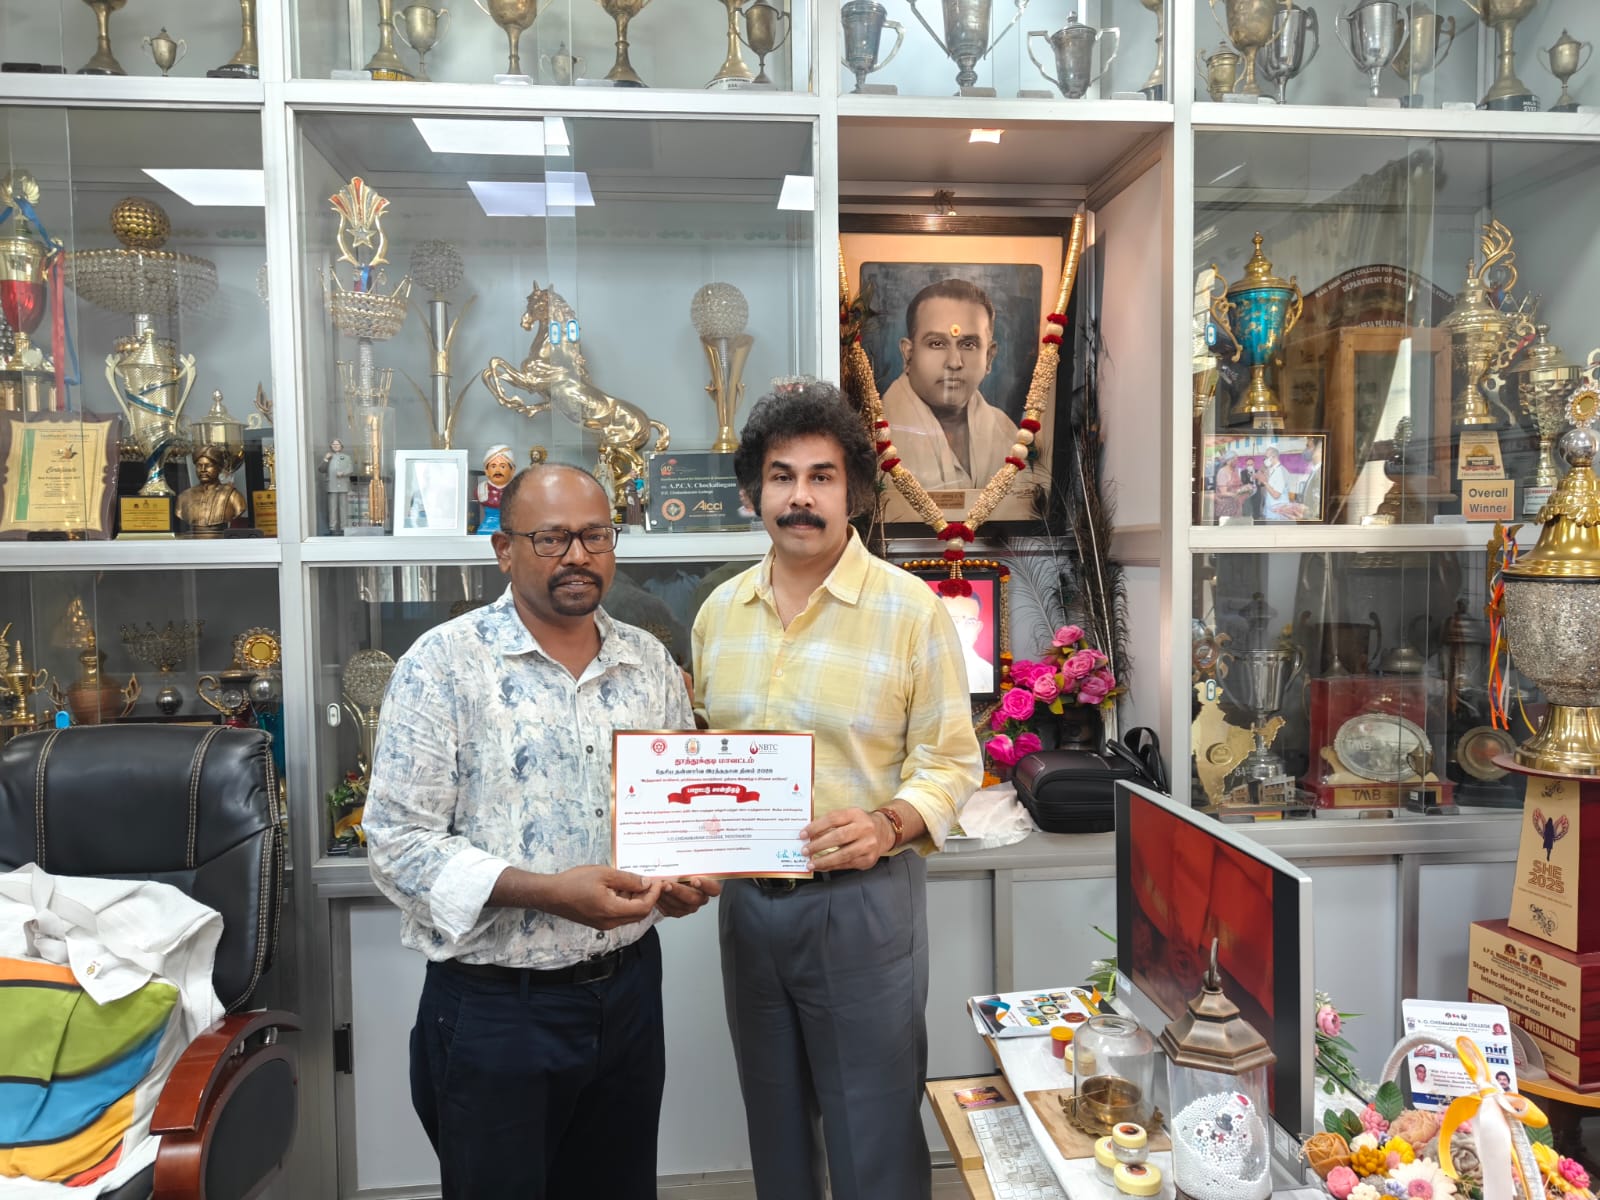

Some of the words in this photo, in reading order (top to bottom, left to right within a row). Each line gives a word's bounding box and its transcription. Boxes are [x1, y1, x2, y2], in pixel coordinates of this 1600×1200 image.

[1356, 267, 1381, 276] COLLEGE
[1342, 276, 1383, 292] DEPARTMENT
[1384, 276, 1393, 284] OF
[1469, 488, 1508, 498] Overall
[1470, 504, 1507, 513] Winner
[758, 743, 778, 751] NBTC
[719, 756, 755, 764] மாவட்டம்
[1352, 789, 1381, 800] TMB
[1533, 860, 1562, 880] SHE
[1528, 871, 1565, 893] 2025
[1472, 961, 1489, 974] Stage
[1490, 967, 1499, 977] for
[1500, 971, 1526, 990] Heritage
[1527, 982, 1539, 995] and
[1540, 990, 1576, 1013] Excellence
[1480, 974, 1524, 999] Intercollegiate
[1525, 994, 1551, 1011] Cultural
[1552, 1006, 1566, 1019] Fest
[1524, 1018, 1550, 1039] OVERALL
[1485, 1043, 1508, 1055] nirf
